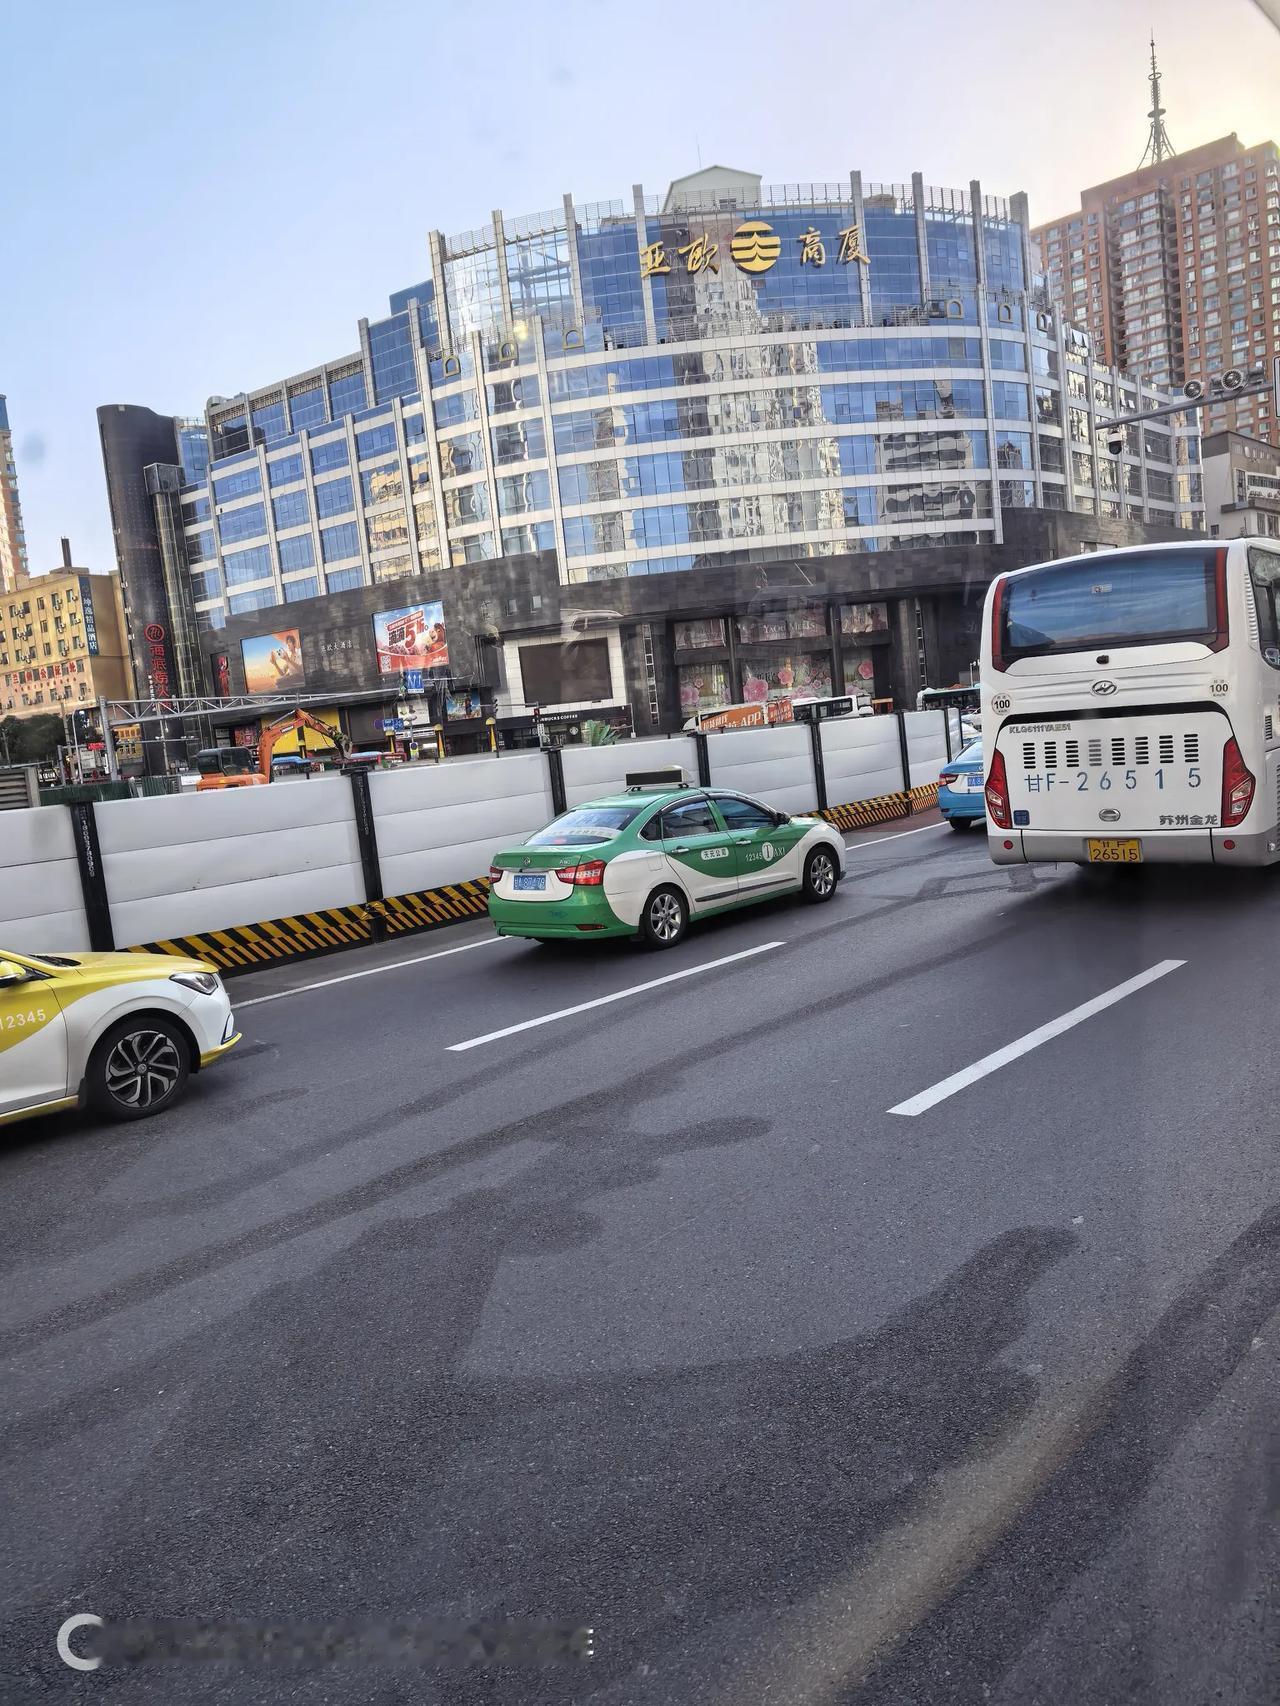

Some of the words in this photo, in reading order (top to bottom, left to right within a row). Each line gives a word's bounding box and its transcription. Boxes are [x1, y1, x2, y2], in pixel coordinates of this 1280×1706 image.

[640, 233, 720, 278] 亚欧
[1209, 683, 1229, 693] 100
[994, 699, 1011, 709] 100
[1159, 815, 1219, 826] 苏州金龙
[1092, 848, 1138, 861] 26515
